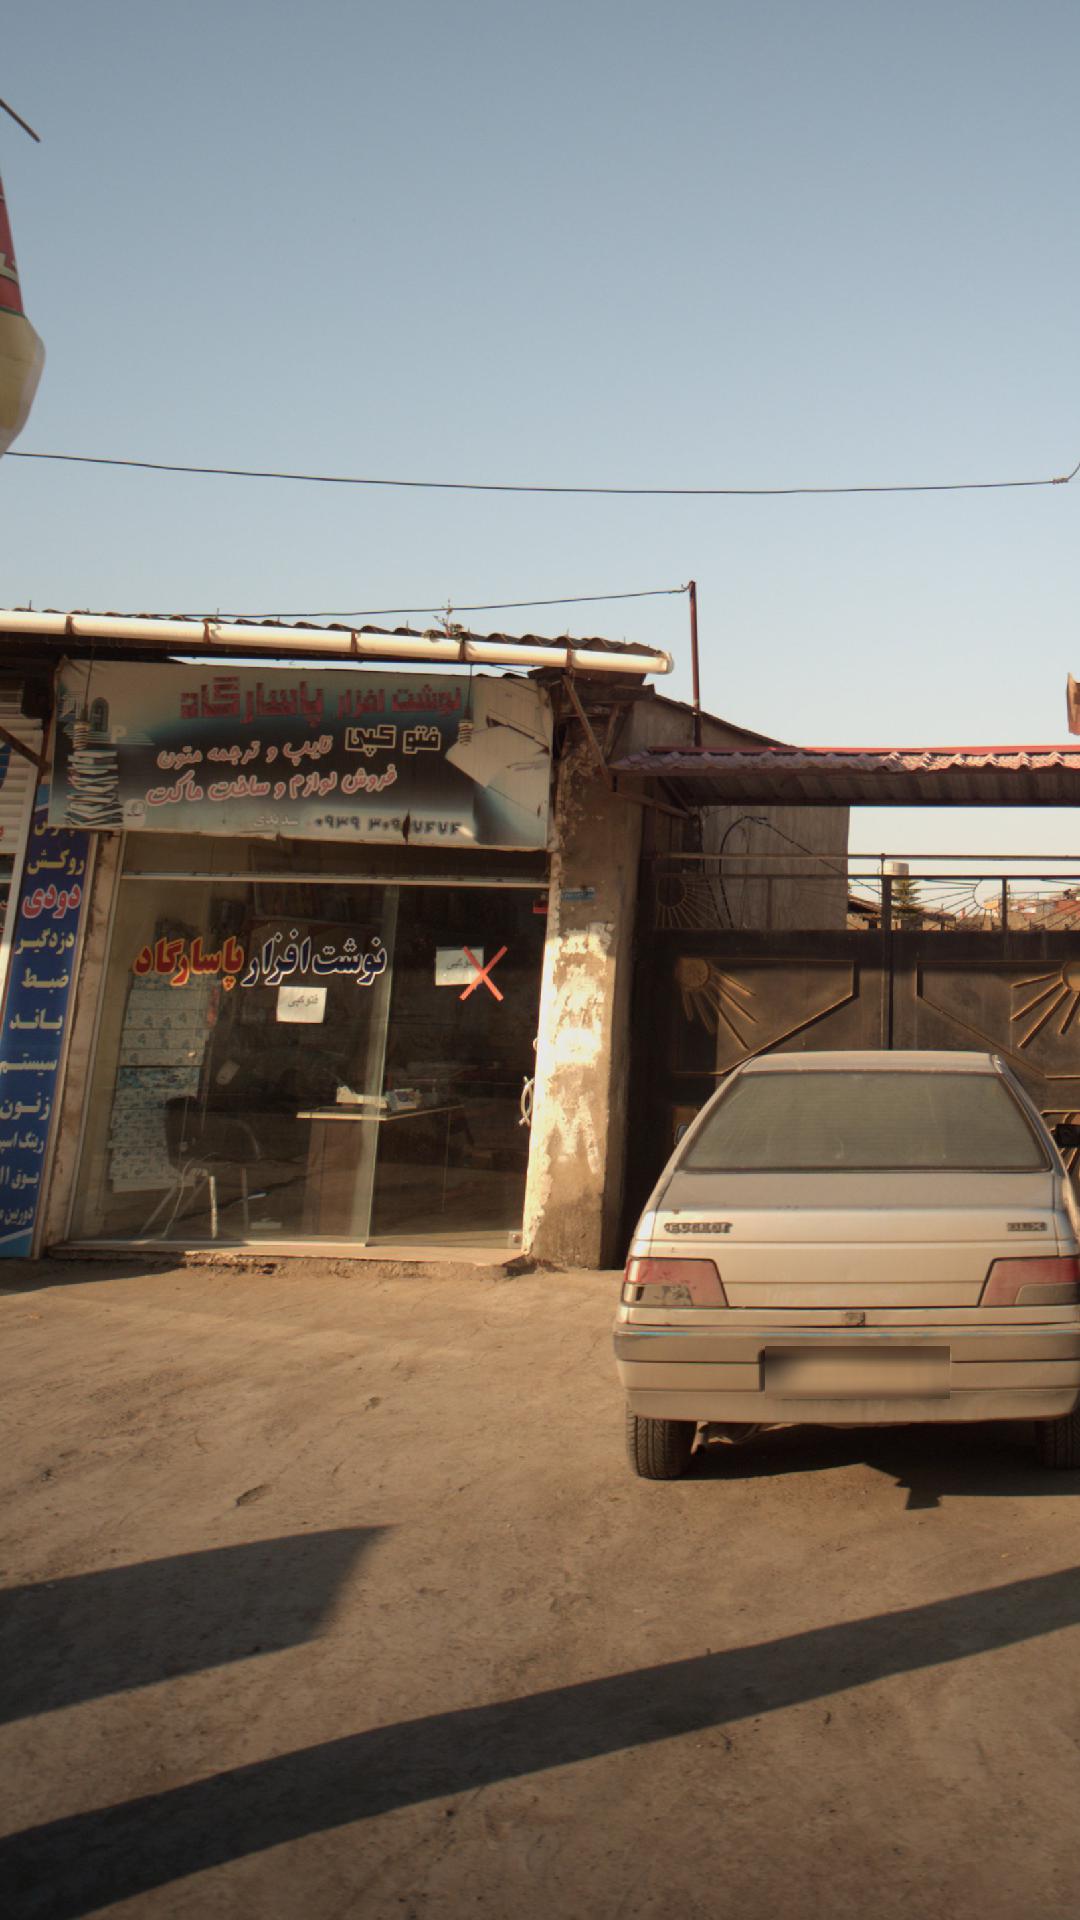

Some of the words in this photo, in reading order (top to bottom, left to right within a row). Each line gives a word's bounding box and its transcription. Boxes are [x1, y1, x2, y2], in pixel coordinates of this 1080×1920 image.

[180, 676, 324, 728] پاسارگاد
[337, 688, 386, 721] افزار
[391, 684, 462, 717] نوشت
[206, 740, 262, 767] ترجمه
[265, 746, 279, 763] و
[282, 735, 334, 768] تایپ
[345, 724, 397, 757] کپی
[402, 725, 442, 755] فتو
[156, 744, 203, 770] متون
[145, 770, 204, 807] ماکت
[208, 775, 270, 801] ساخت
[273, 782, 285, 801] و
[289, 771, 338, 800] لوازم
[341, 764, 398, 795] فروش
[27, 849, 85, 876] روکش
[22, 884, 82, 919] دودی
[15, 928, 75, 955] دزدگیر
[132, 936, 245, 991] پاسارگاد
[241, 928, 312, 988] افزار
[311, 937, 388, 987] نوشت
[21, 967, 70, 994] ضبط
[9, 1008, 63, 1036] باند
